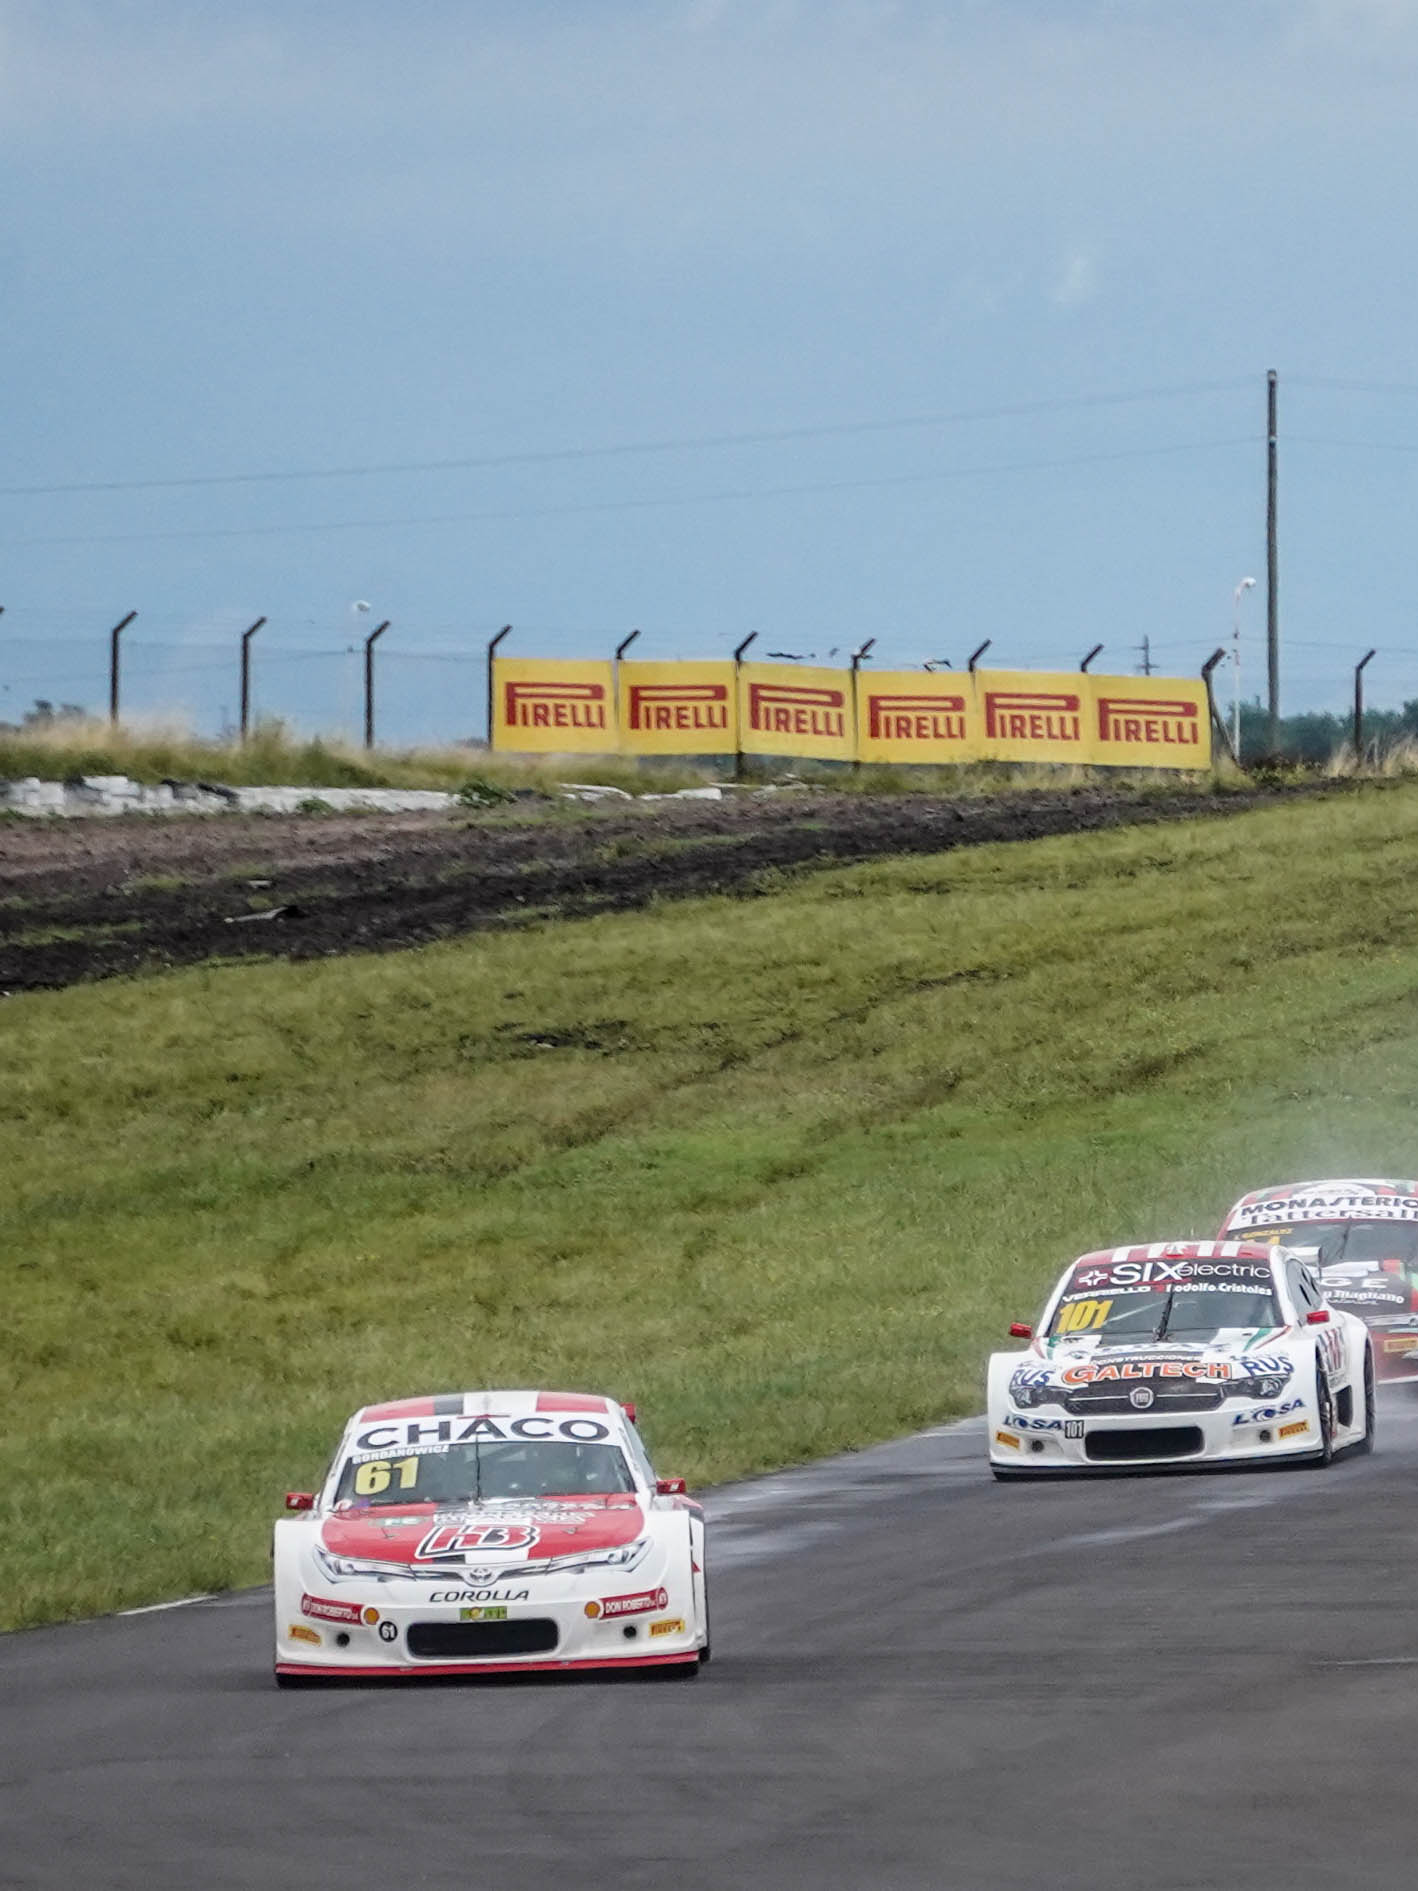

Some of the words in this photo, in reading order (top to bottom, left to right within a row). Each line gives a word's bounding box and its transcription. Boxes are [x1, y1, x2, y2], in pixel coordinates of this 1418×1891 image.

[505, 682, 605, 728] PIRELLI
[628, 685, 728, 729] PIRELLI
[750, 683, 845, 736] PIRELLI
[869, 695, 966, 739] PIRELLI
[986, 692, 1080, 740] PIRELLI
[1099, 698, 1199, 744] PIRELLI
[1056, 1300, 1114, 1334] 101
[1011, 1368, 1055, 1388] RUS
[1061, 1360, 1233, 1385] GALTECH
[1242, 1355, 1295, 1376] RUS
[357, 1417, 610, 1450] CHACO
[1066, 1421, 1083, 1438] 101
[355, 1456, 419, 1495] 61
[430, 1590, 530, 1603] COROLLA
[381, 1623, 396, 1640] 61
